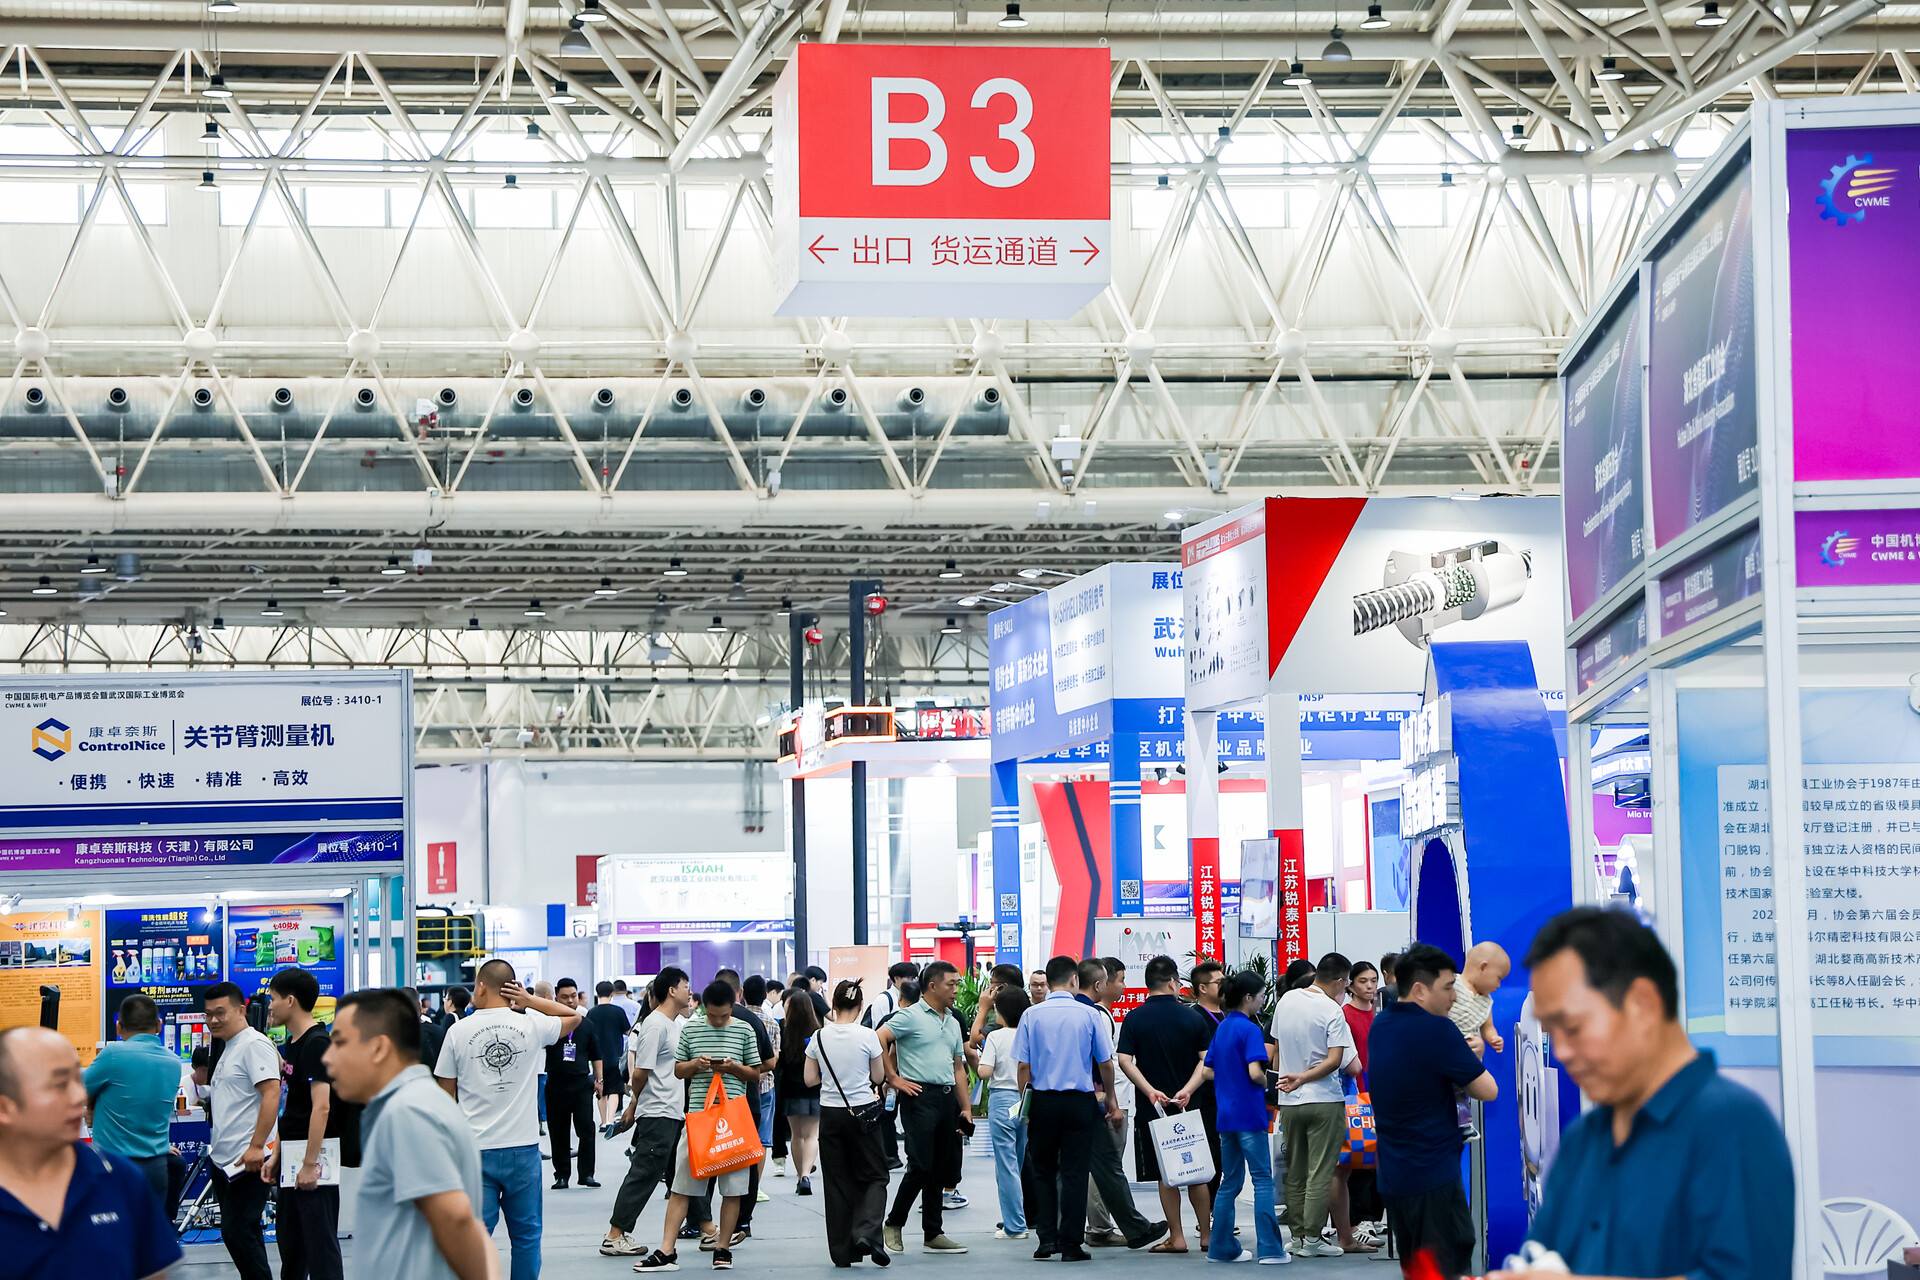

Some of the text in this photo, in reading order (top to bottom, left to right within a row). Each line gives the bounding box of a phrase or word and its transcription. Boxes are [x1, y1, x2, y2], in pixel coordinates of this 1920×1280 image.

[1854, 197, 1890, 207] CWME
[853, 235, 1058, 266] 出口 货运通道
[1871, 552, 1915, 561] CWME &
[5, 689, 185, 701] 中国国际机电产品博览会暨武汉国际工业博览会
[88, 725, 159, 738] 康卓奈斯
[184, 723, 335, 749] 关节臂测量机
[78, 740, 166, 753] ControlNice
[70, 769, 309, 791] 便携 快速 精准 高效
[126, 855, 167, 864] Technology
[682, 865, 724, 873] ISAIAH
[1726, 888, 1862, 899] 技术国家 验室大楼。
[1728, 953, 1775, 965] 任第六届
[1809, 975, 1913, 986] 长等8人任副会长，
[1810, 997, 1920, 1008] 工任秘书长。华中
